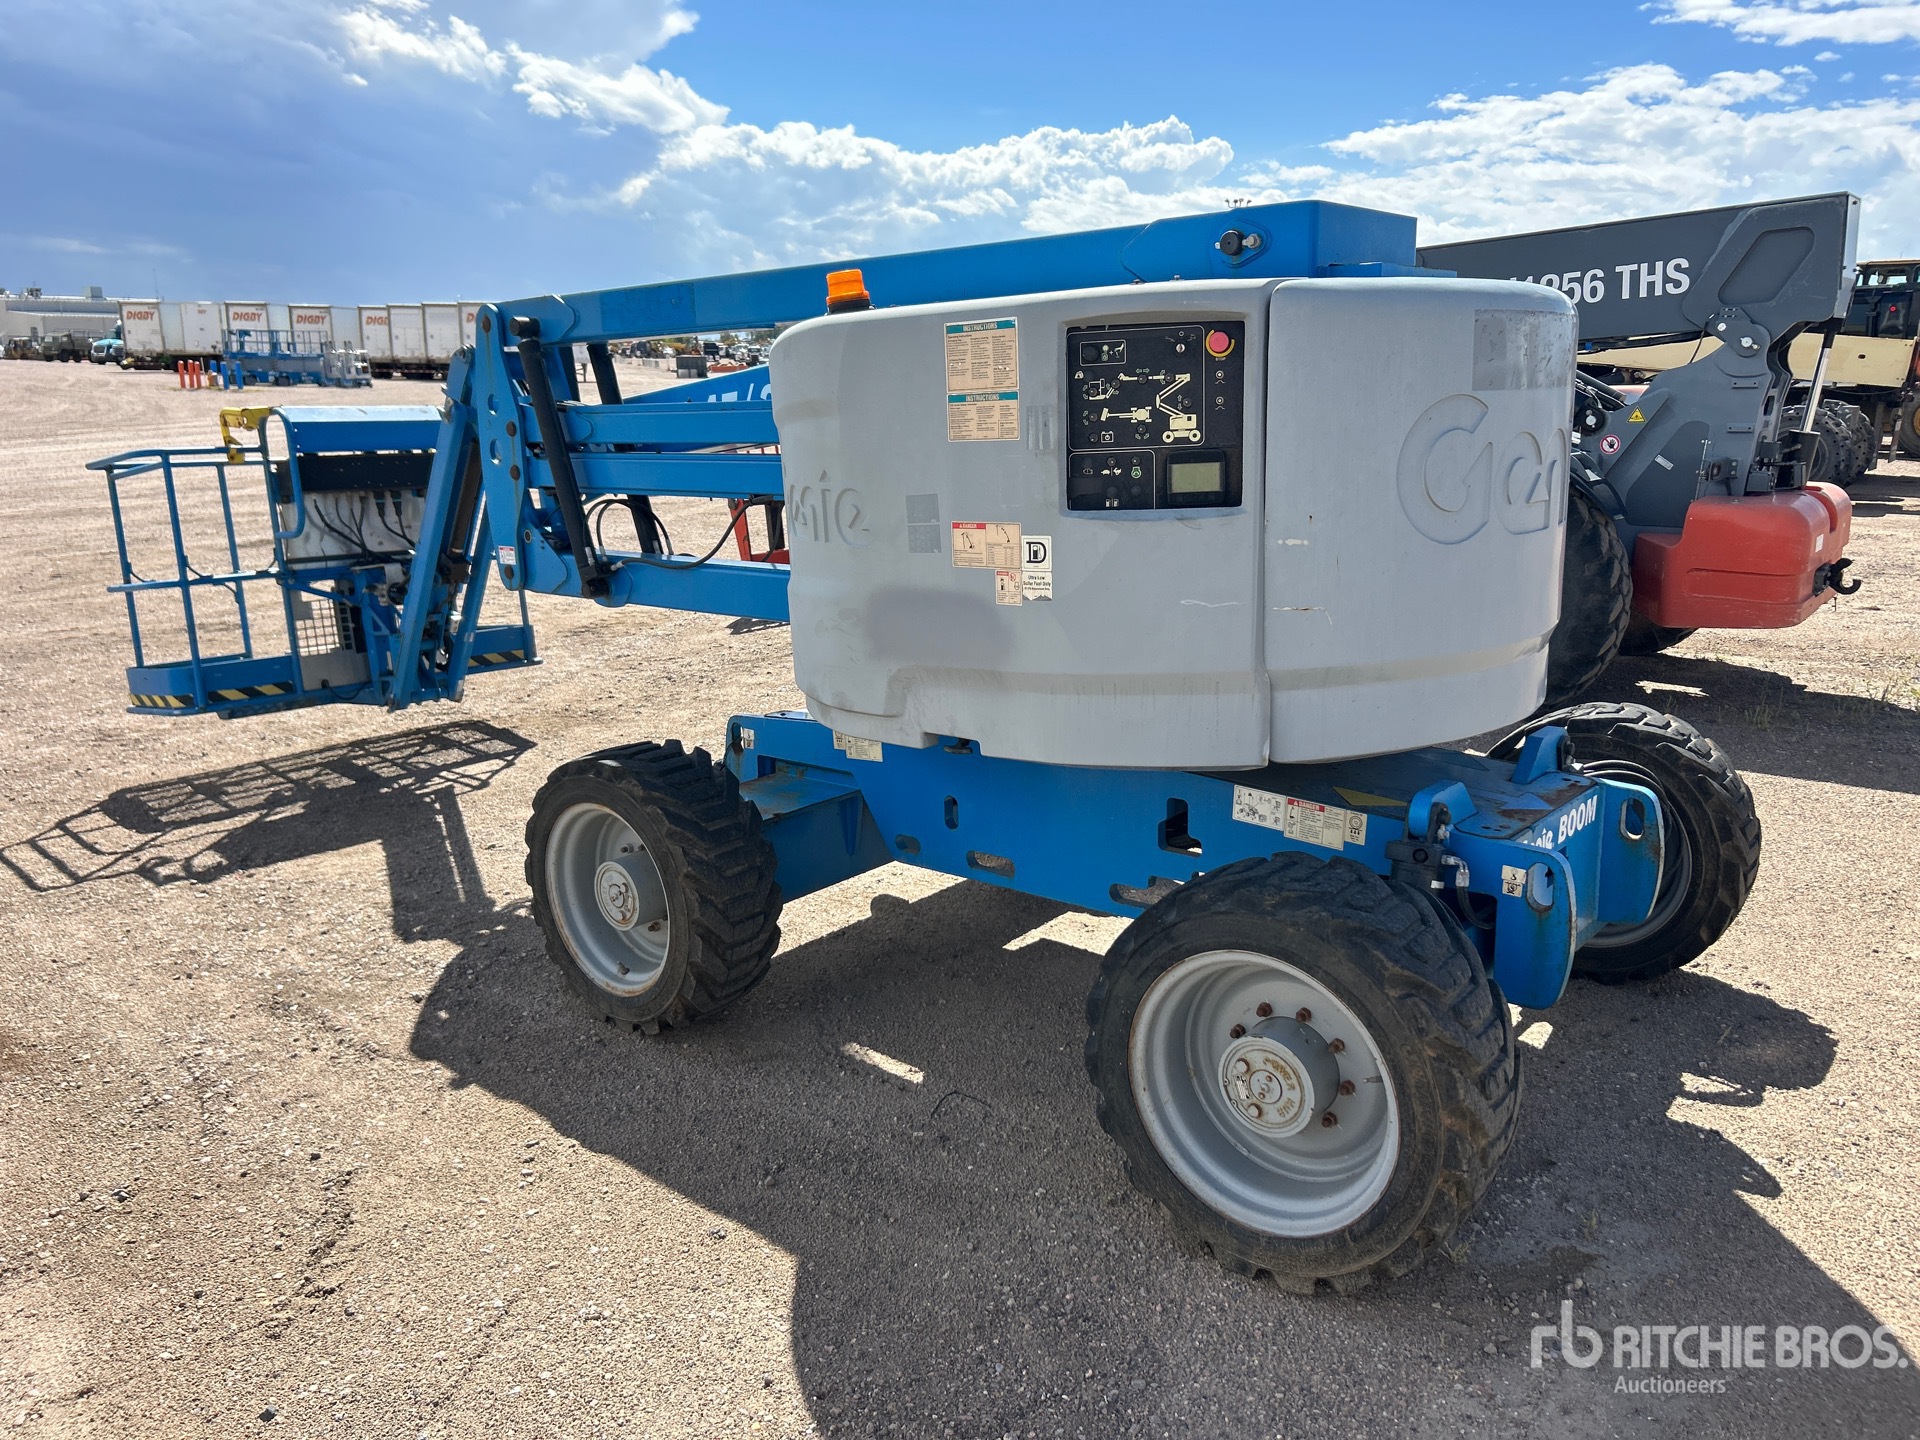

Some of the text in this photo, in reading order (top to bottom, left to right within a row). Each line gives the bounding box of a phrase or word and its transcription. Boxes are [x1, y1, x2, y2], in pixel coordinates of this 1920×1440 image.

[1615, 257, 1690, 300] THS
[126, 310, 155, 322] DIGBY
[232, 311, 263, 323] DIGBY
[296, 314, 327, 326] DIGBY
[963, 322, 997, 332] INSTRUCTIONS
[966, 393, 999, 402] INSTRUCTIONS
[1026, 541, 1047, 564] D
[1299, 801, 1320, 811] DANGER
[1558, 795, 1598, 845] BOOM
